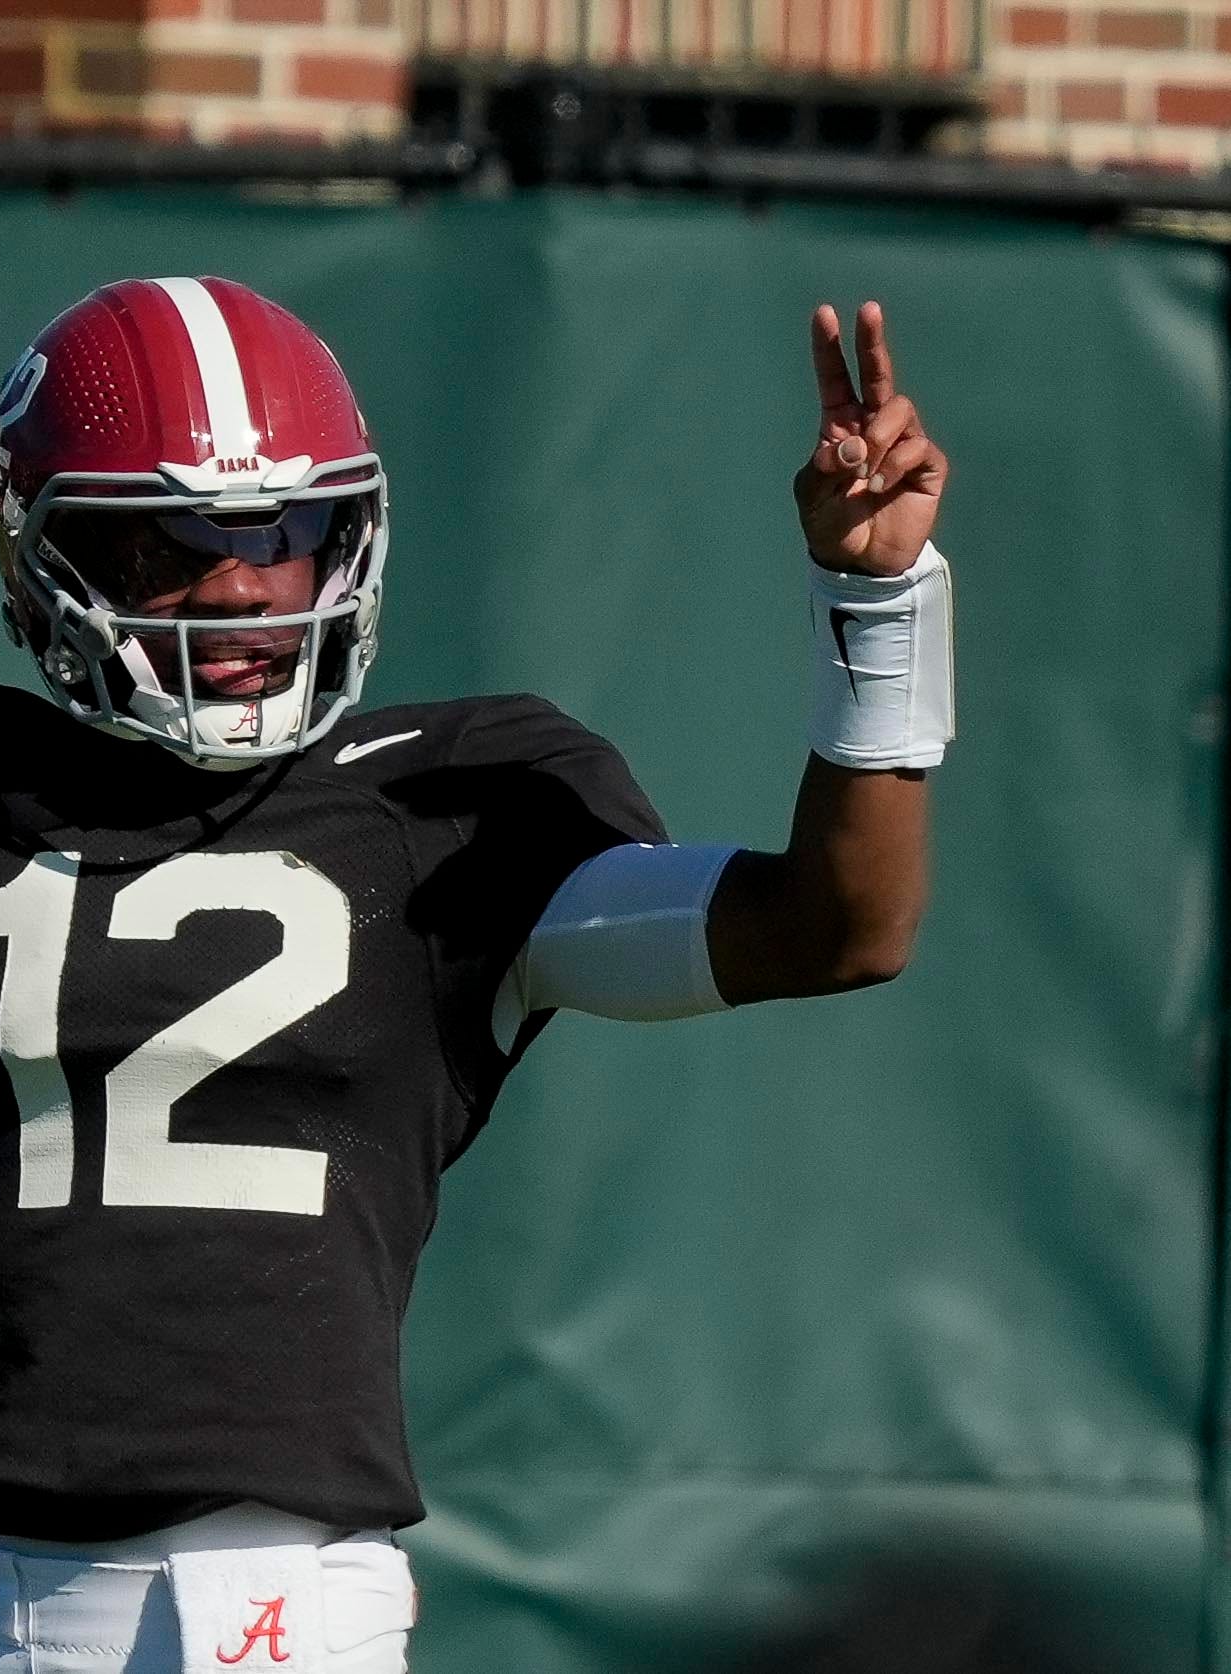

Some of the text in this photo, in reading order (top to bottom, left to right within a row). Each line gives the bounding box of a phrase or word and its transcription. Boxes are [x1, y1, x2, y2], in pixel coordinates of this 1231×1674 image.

[217, 457, 259, 473] BAMA
[228, 702, 257, 731] A
[216, 1596, 290, 1664] A
